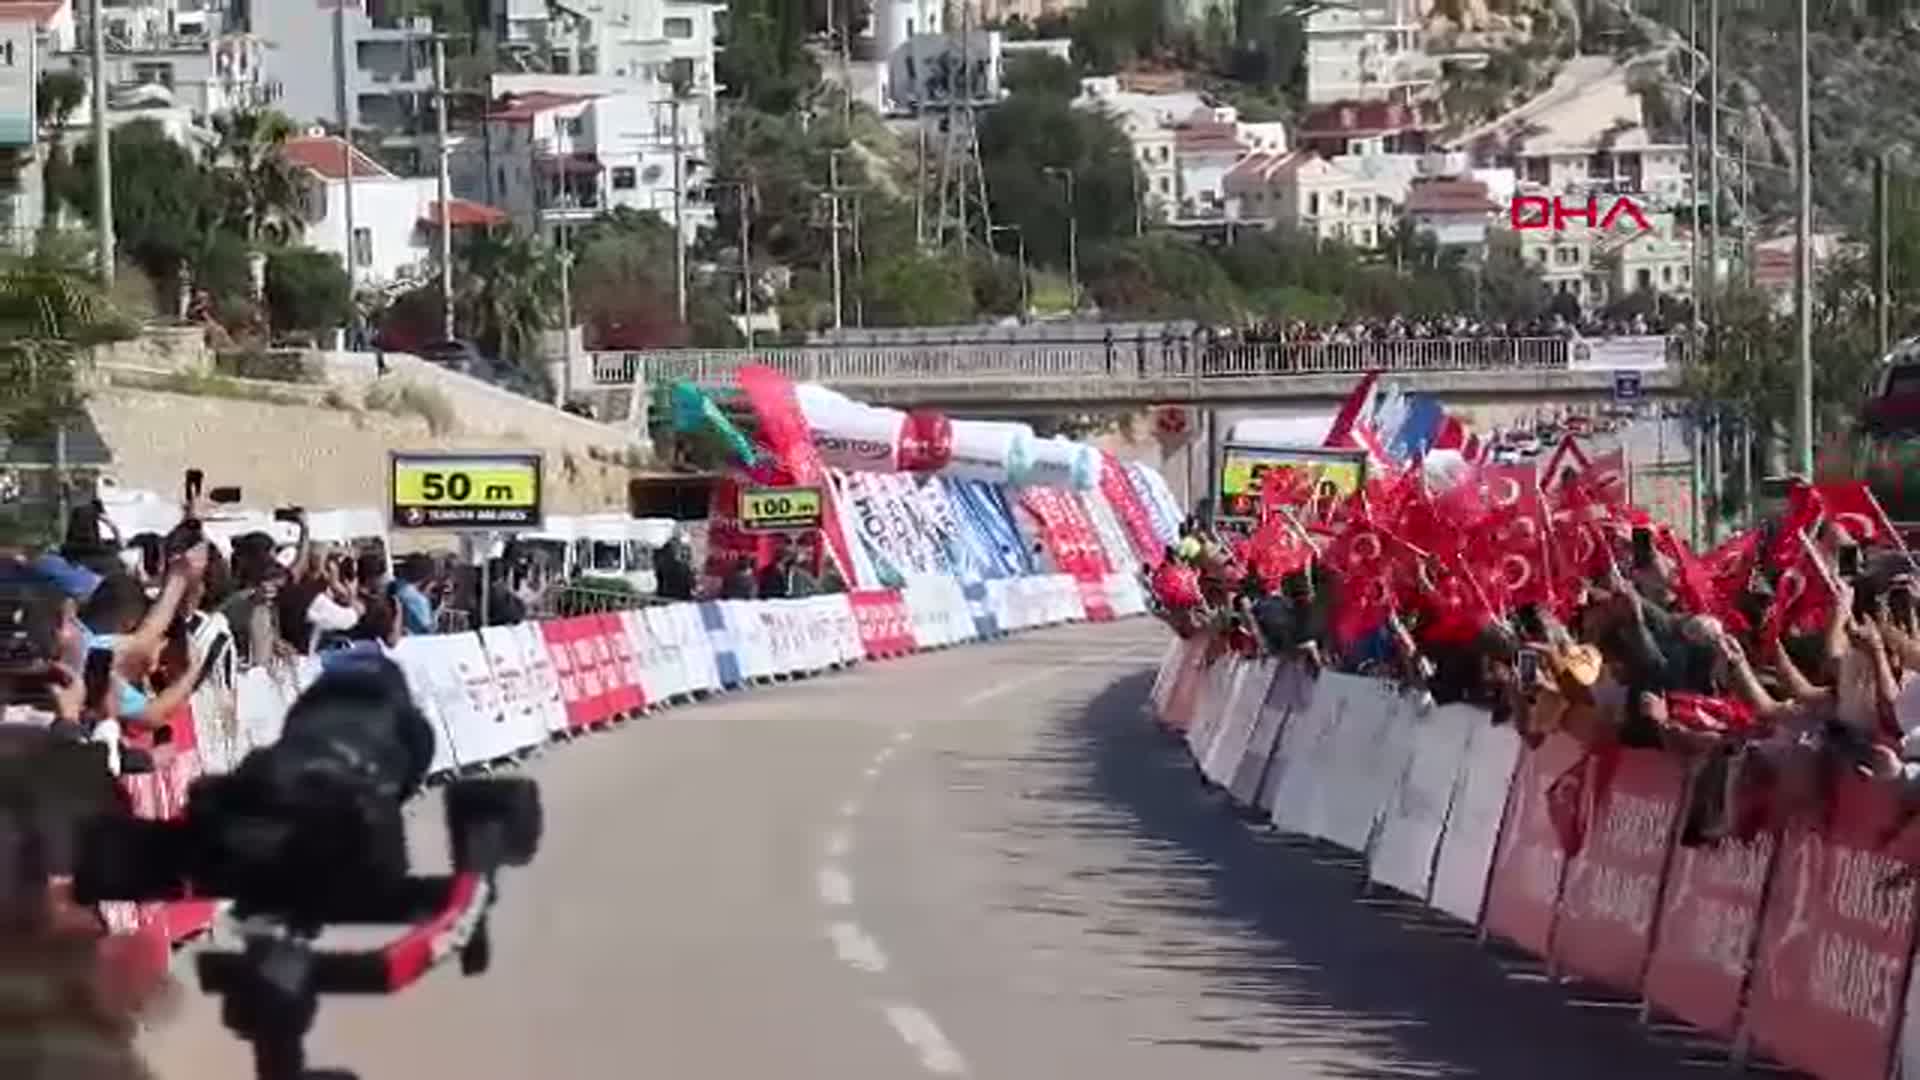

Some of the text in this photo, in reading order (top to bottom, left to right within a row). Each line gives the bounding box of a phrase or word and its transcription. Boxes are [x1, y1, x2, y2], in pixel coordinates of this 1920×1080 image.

[422, 472, 514, 501] 50 m
[752, 498, 791, 515] 100
